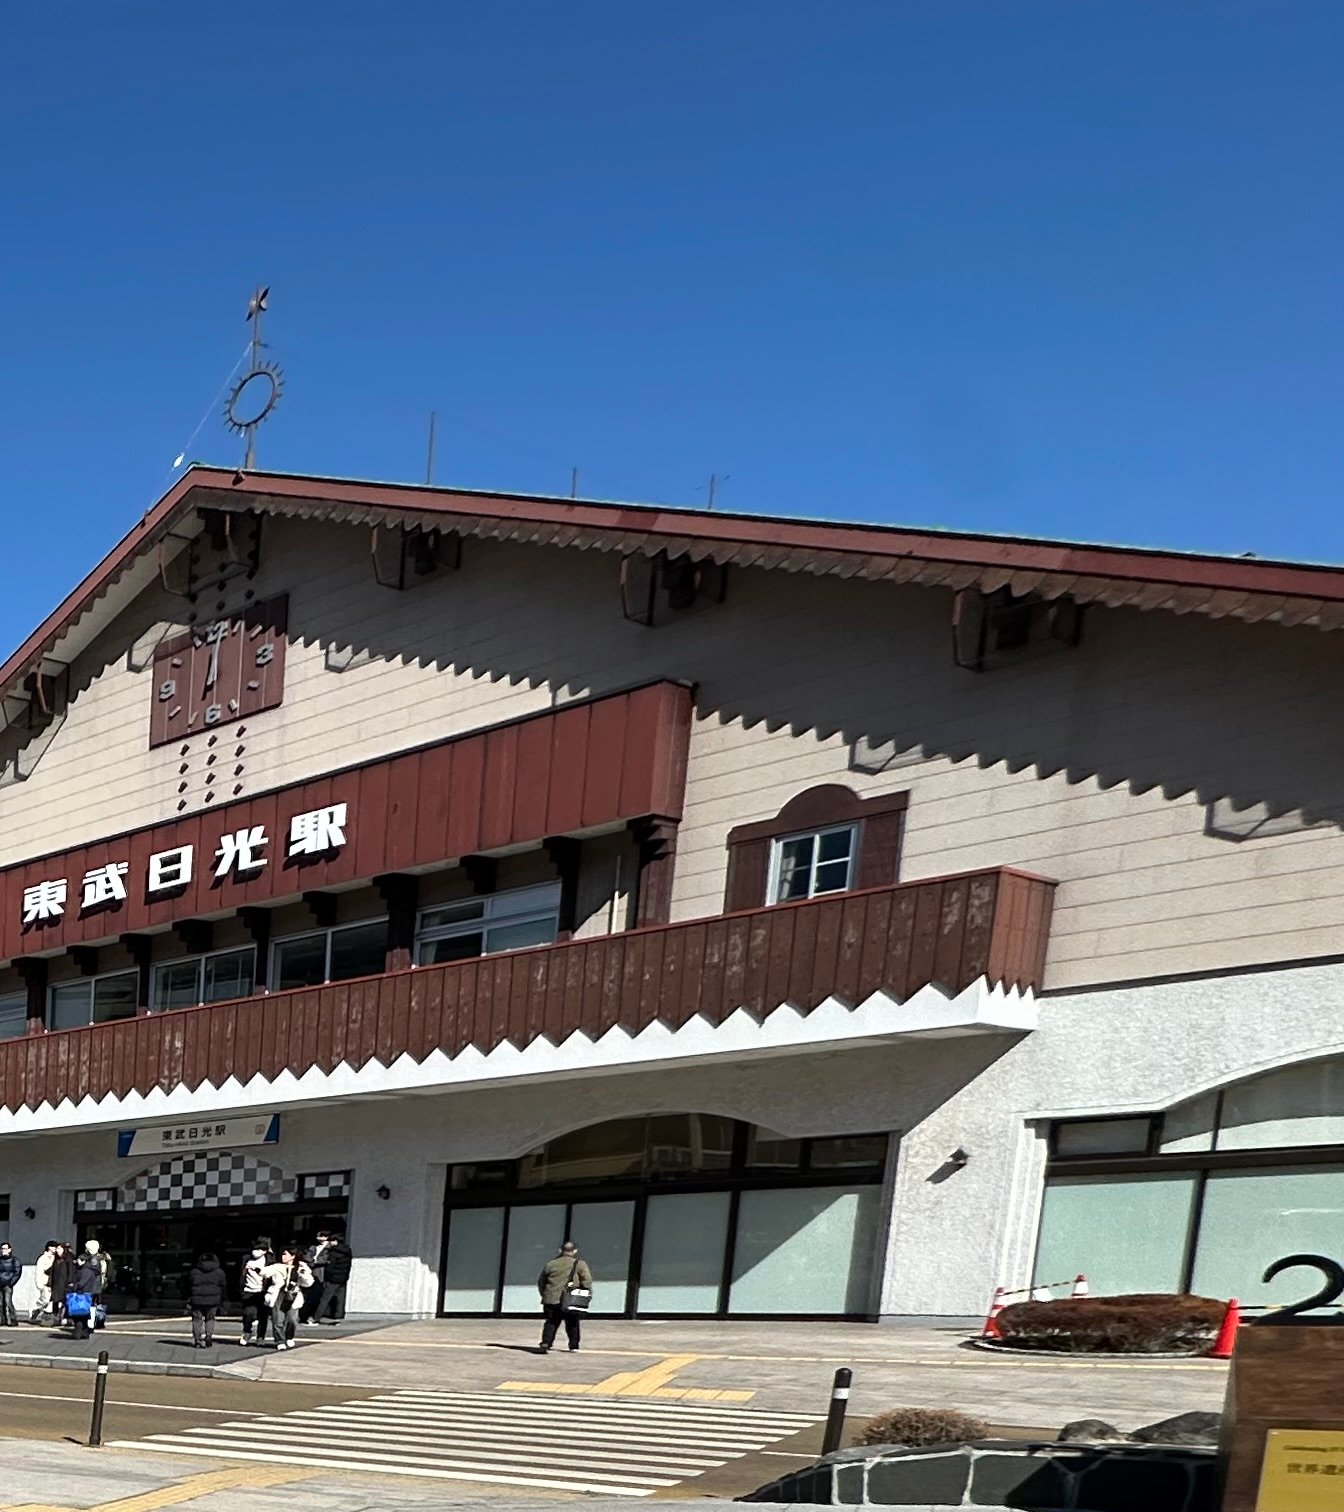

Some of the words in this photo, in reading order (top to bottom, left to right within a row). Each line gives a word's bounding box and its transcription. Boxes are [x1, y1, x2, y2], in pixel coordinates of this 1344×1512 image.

[257, 644, 274, 666] 3
[160, 679, 176, 701] 9
[205, 703, 222, 725] 6
[23, 803, 348, 923] 東武日光駅
[162, 1124, 226, 1141] 東武日光駅
